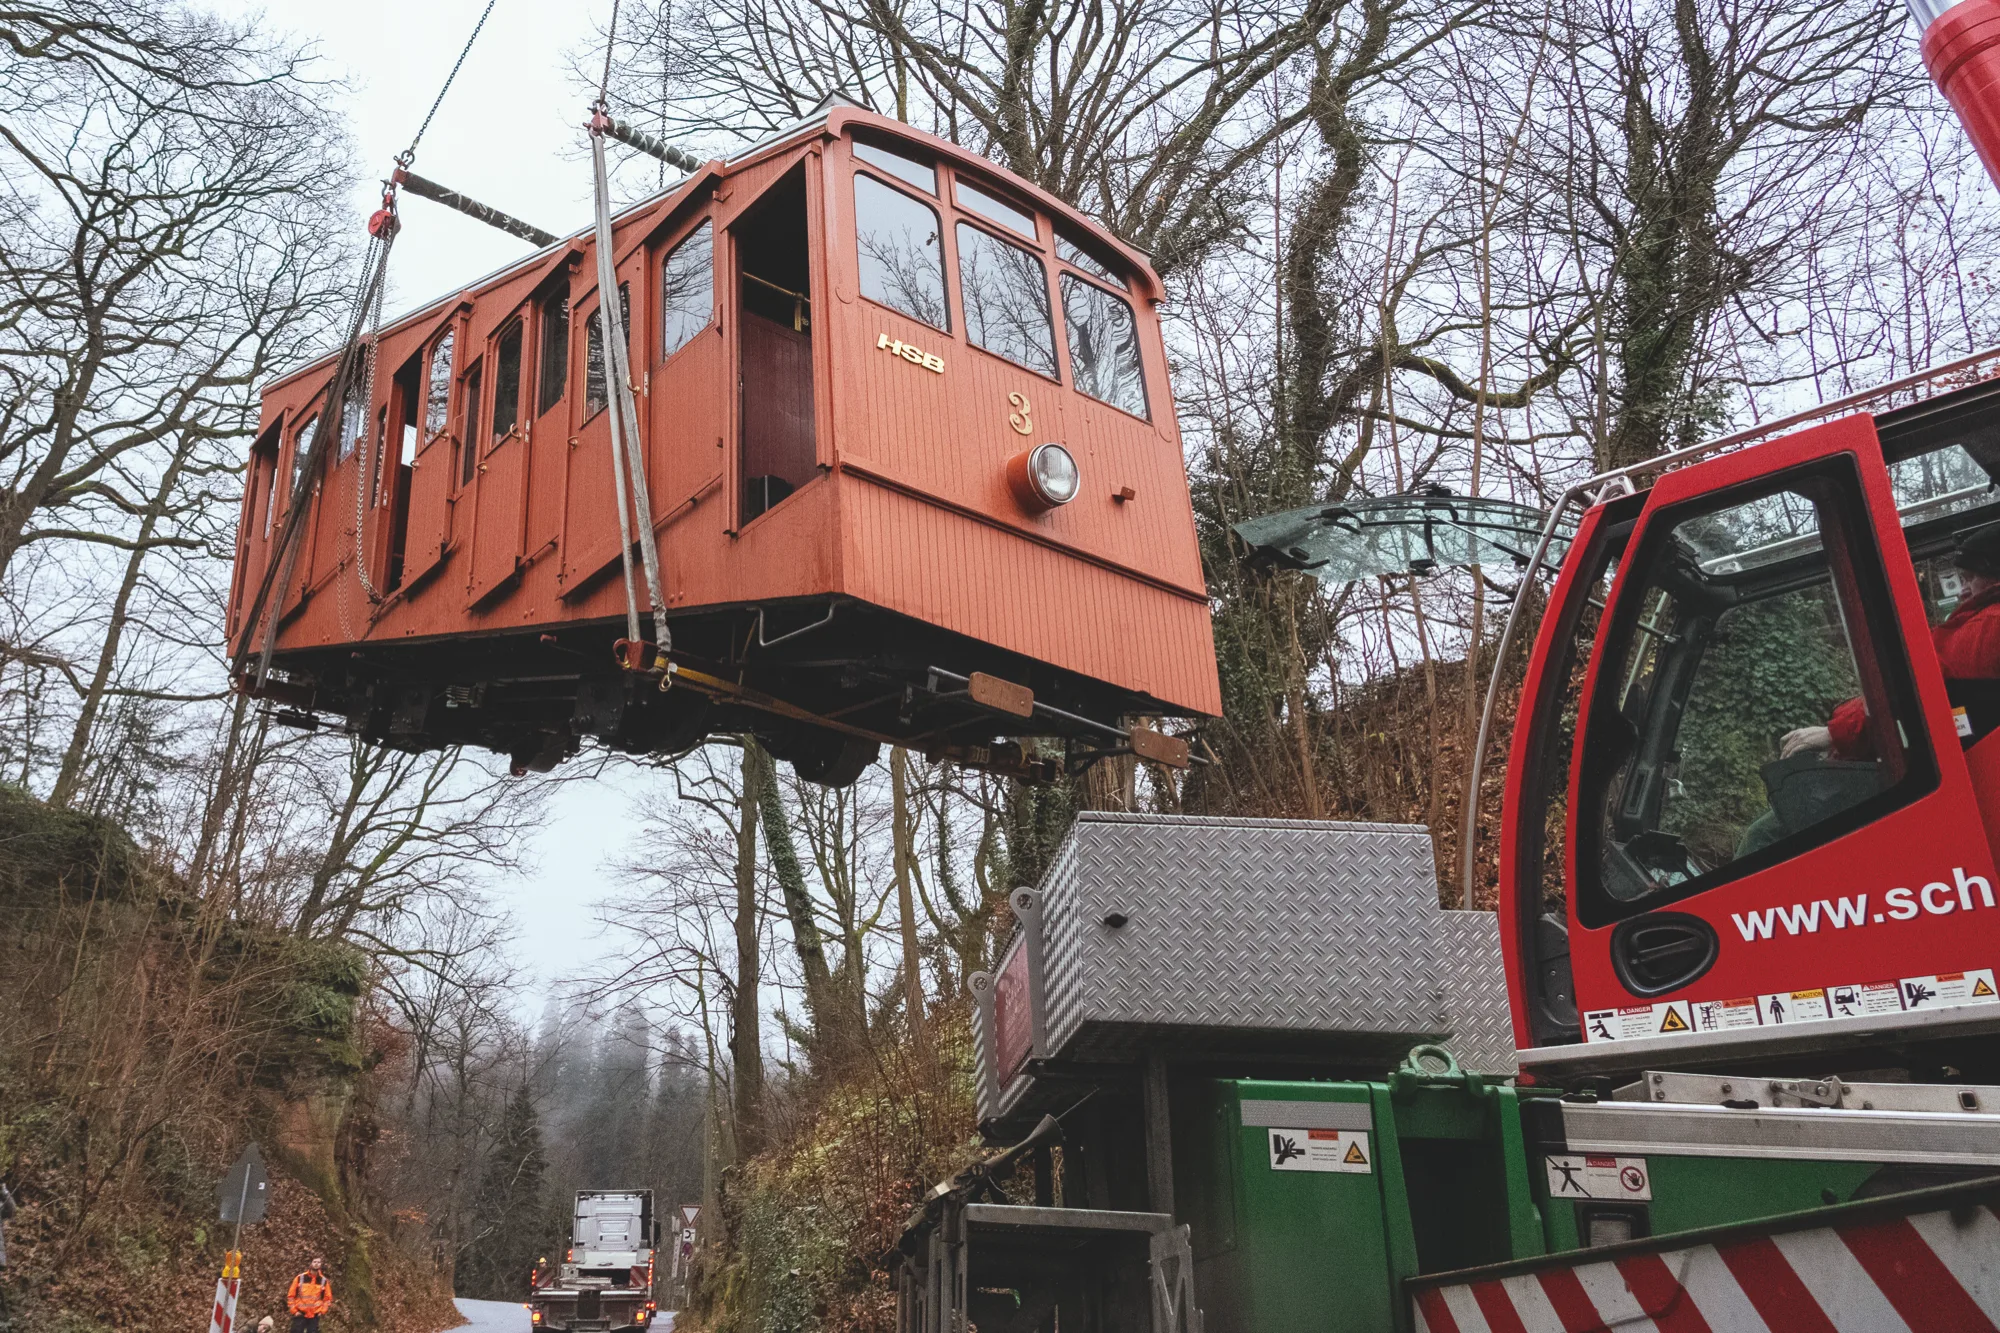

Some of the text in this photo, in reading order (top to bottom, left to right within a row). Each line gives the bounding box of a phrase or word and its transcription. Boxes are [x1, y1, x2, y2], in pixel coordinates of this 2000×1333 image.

[877, 333, 945, 374] HSB
[1008, 391, 1033, 435] 3
[1731, 867, 1996, 942] www.sch
[1869, 983, 1895, 991] DANGER
[1626, 1006, 1651, 1014] DANGER
